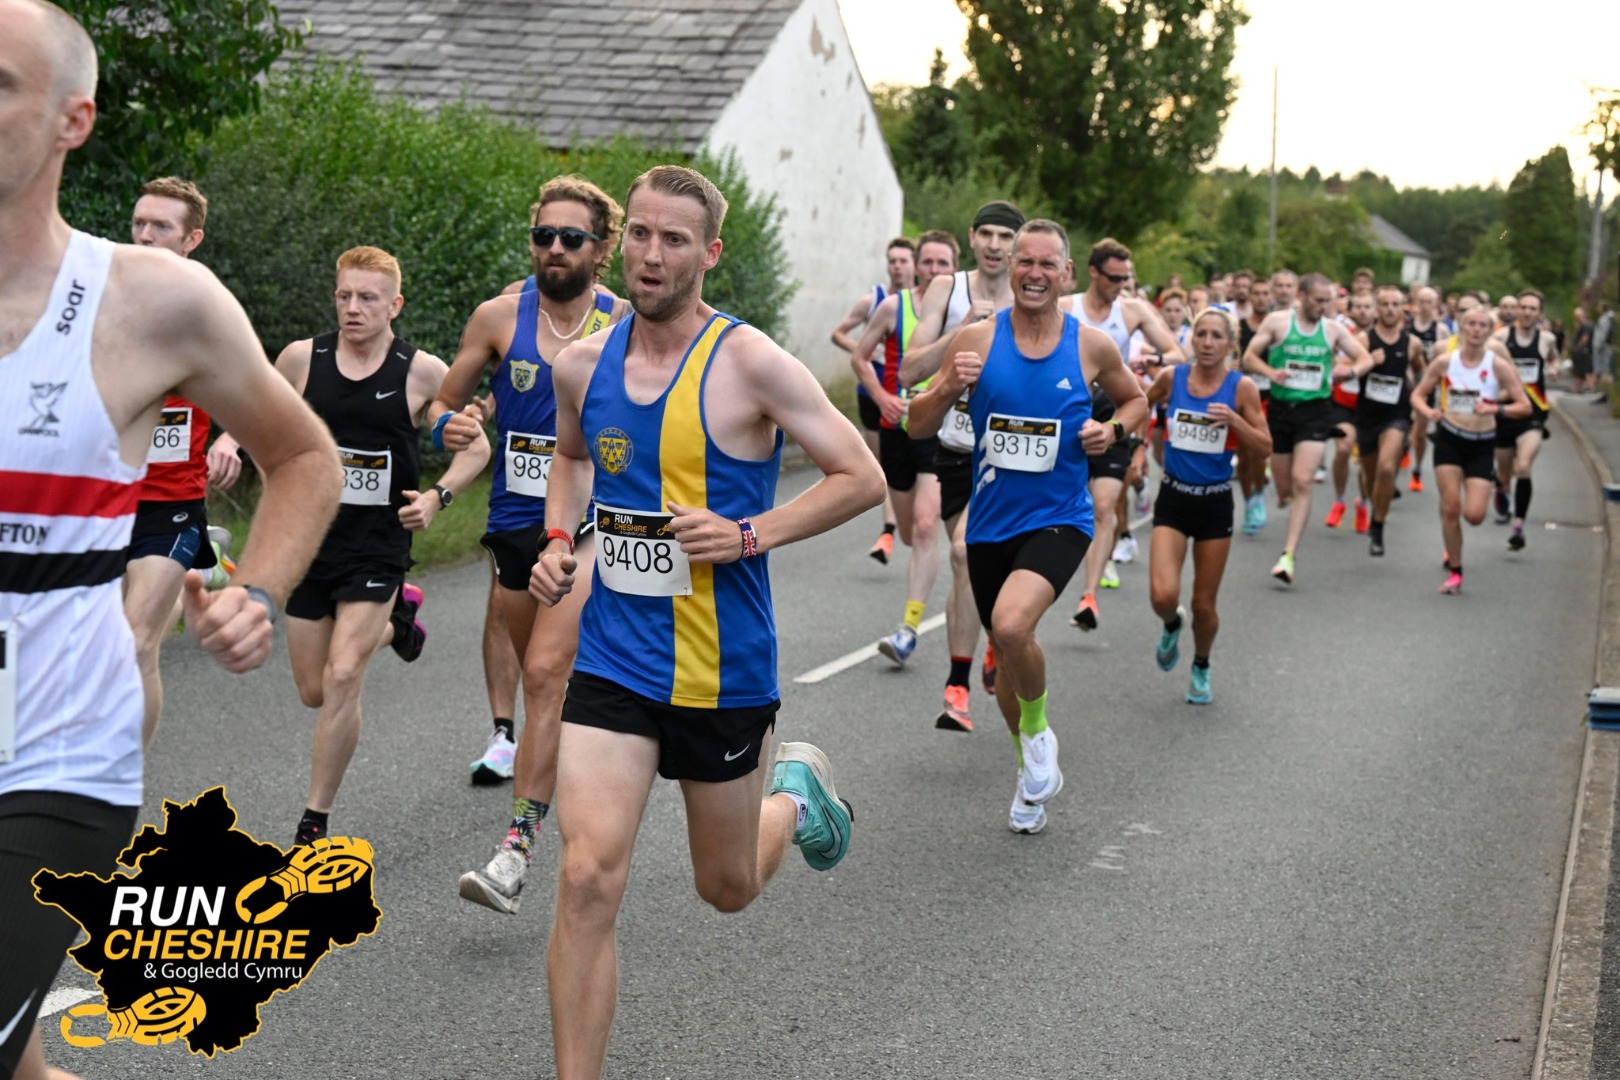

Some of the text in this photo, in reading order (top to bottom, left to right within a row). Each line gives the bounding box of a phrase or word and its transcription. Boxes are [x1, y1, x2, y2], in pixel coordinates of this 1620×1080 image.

[56, 279, 86, 336] soar
[529, 438, 547, 447] RUN
[992, 433, 1048, 458] 9315
[613, 522, 648, 533] CHESHIRE
[614, 513, 634, 525] RUN
[602, 535, 674, 574] 9408
